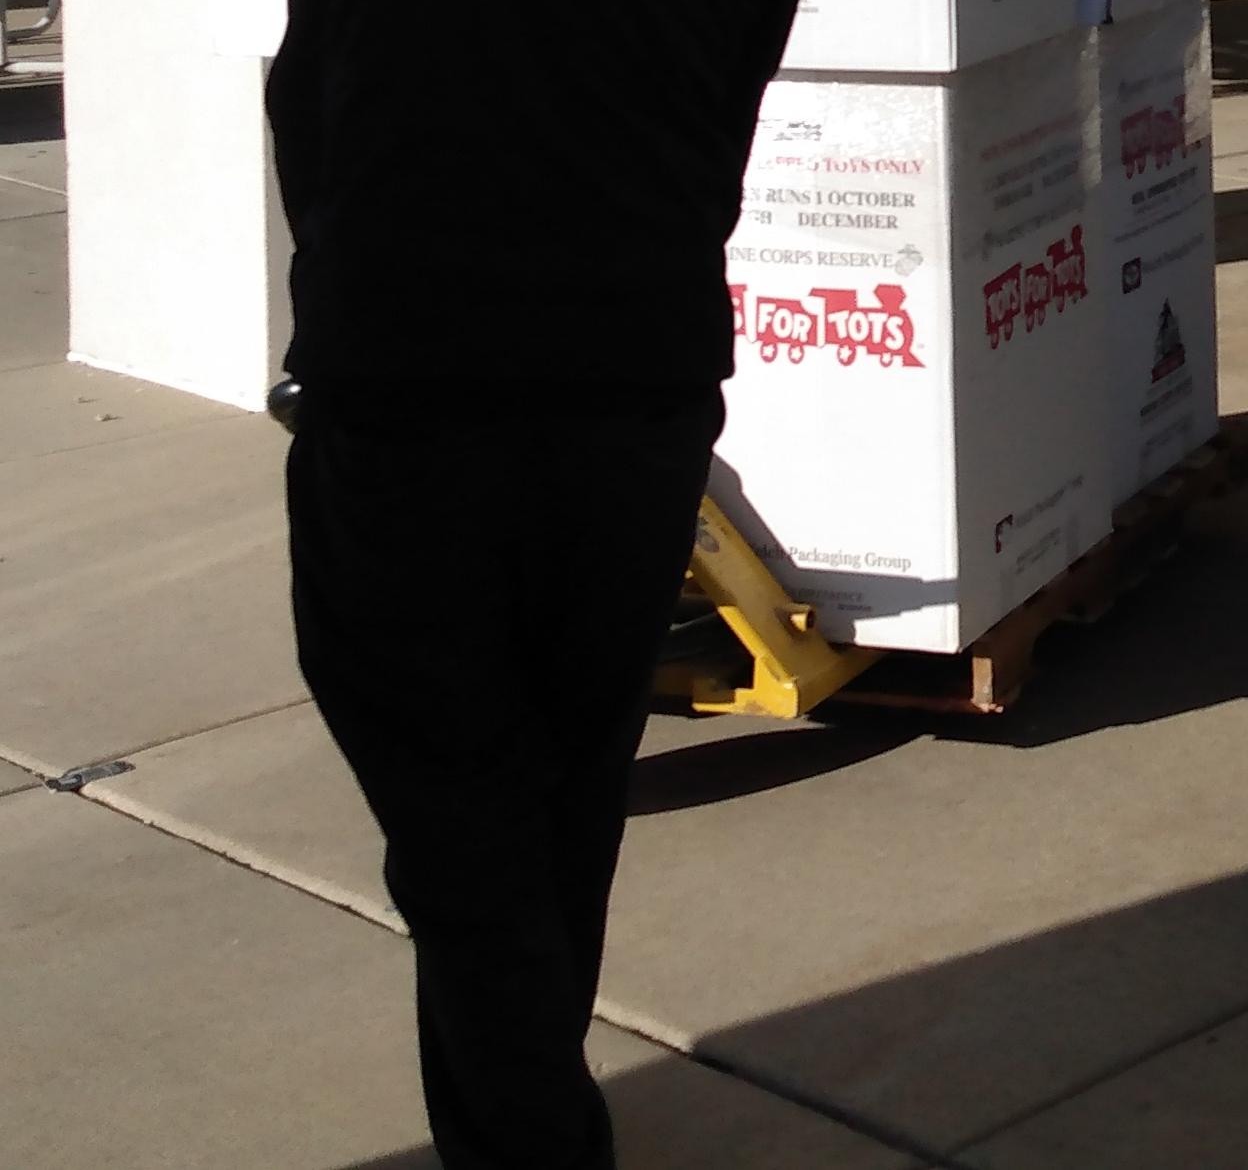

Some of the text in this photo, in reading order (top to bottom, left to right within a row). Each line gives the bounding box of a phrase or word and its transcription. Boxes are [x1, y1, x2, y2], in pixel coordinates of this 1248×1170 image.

[822, 156, 871, 174] TOYS
[874, 158, 924, 176] ONLY
[765, 188, 812, 205] RUNS
[827, 190, 916, 208] OCTOBER
[797, 211, 899, 230] DECEMBER
[729, 246, 894, 269] INE CORPS RESERVE
[758, 302, 812, 343] FOR
[827, 308, 905, 351] TOTS
[788, 546, 862, 569] Packaging
[864, 551, 912, 573] Group
